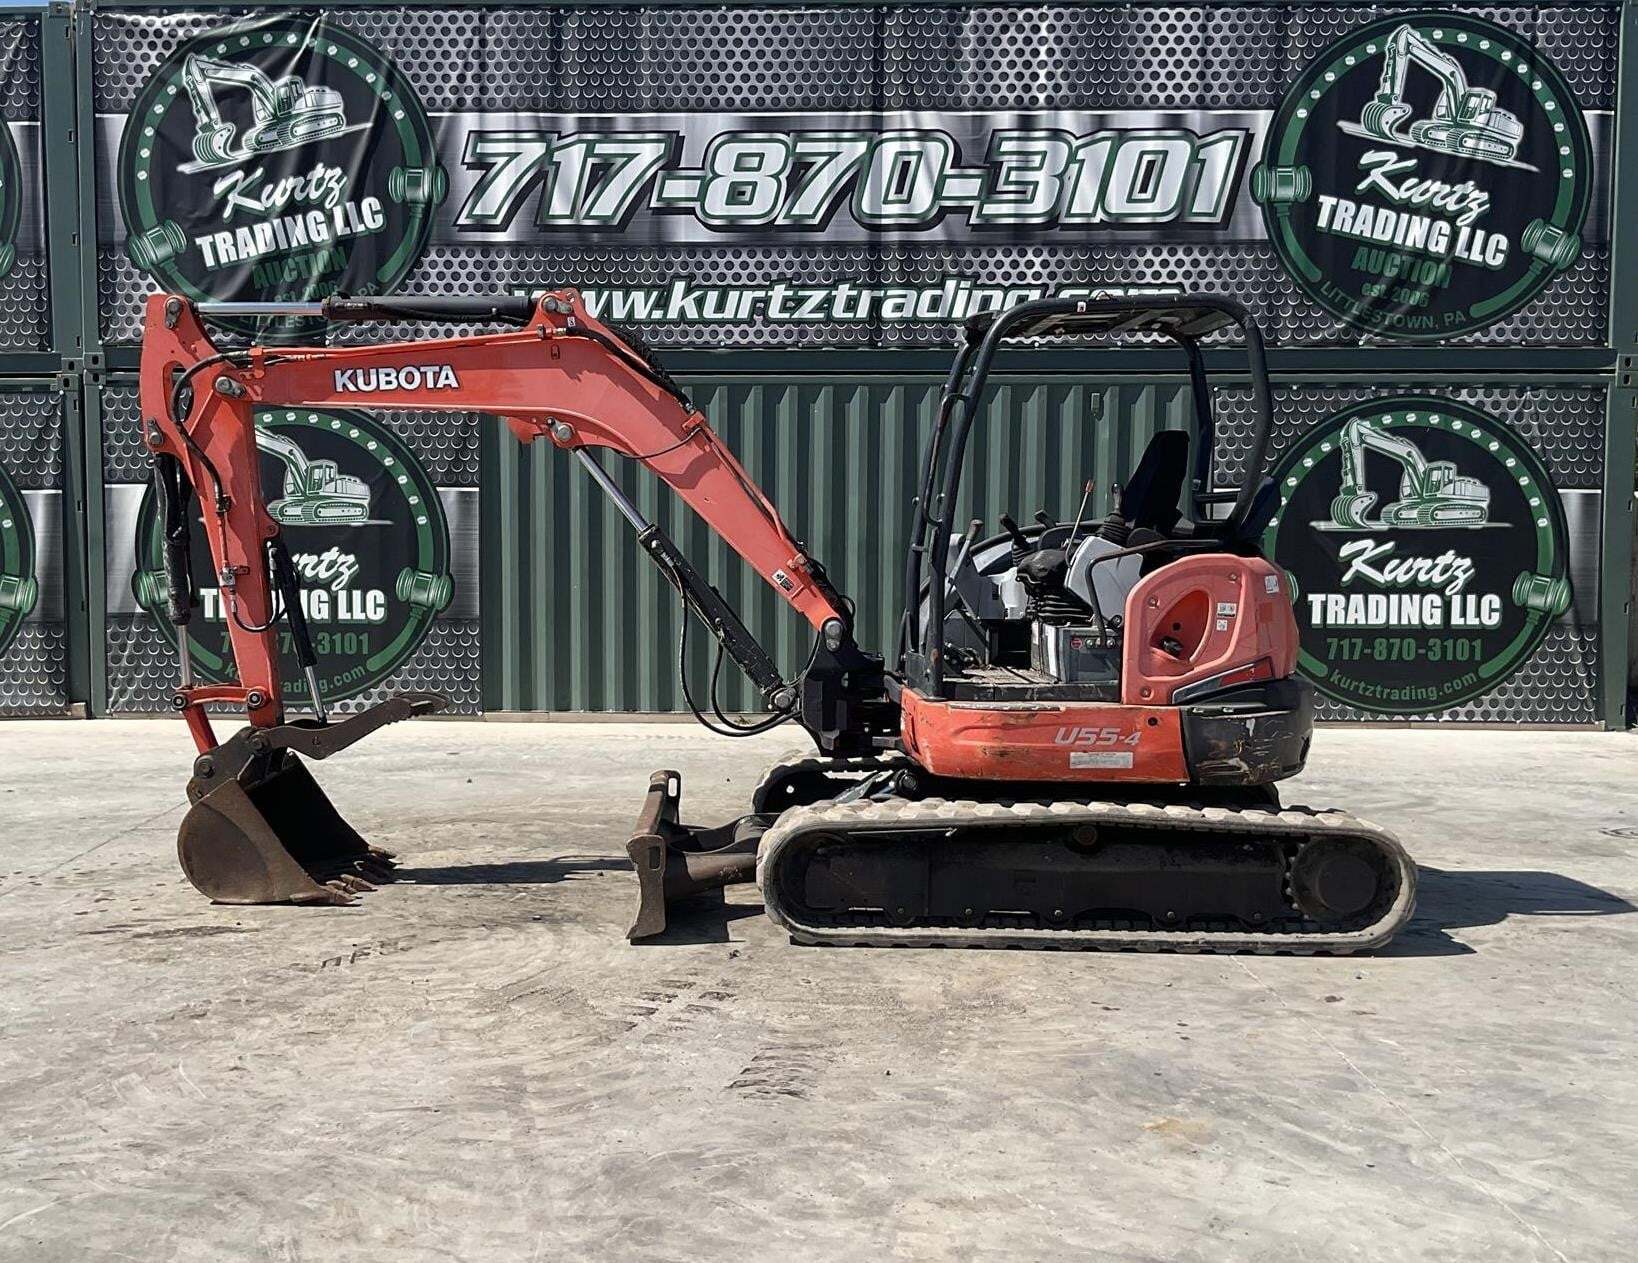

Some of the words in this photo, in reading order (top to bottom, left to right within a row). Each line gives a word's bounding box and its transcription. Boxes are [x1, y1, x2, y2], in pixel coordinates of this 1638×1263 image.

[213, 162, 348, 220] Kurtz
[457, 131, 1246, 230] 717-870-3101
[1356, 150, 1490, 227] Kurtz
[195, 209, 330, 268] TRADING
[332, 196, 385, 236] LLC
[1316, 194, 1452, 255] TRADING
[1454, 226, 1509, 267] LLC
[252, 246, 348, 289] AUCTION
[1351, 246, 1453, 289] AUCTION
[1444, 310, 1466, 327] PA
[333, 364, 460, 393] KUBOTA
[291, 546, 359, 591] rtz
[1339, 538, 1476, 596] Kurtz
[337, 589, 386, 621] LLC
[1307, 593, 1442, 627] TRADING
[1449, 593, 1502, 627] LLC
[1326, 637, 1483, 662] 717-870-3101
[1329, 668, 1478, 700] kurtztrading.com
[1055, 727, 1142, 747] U55-4
